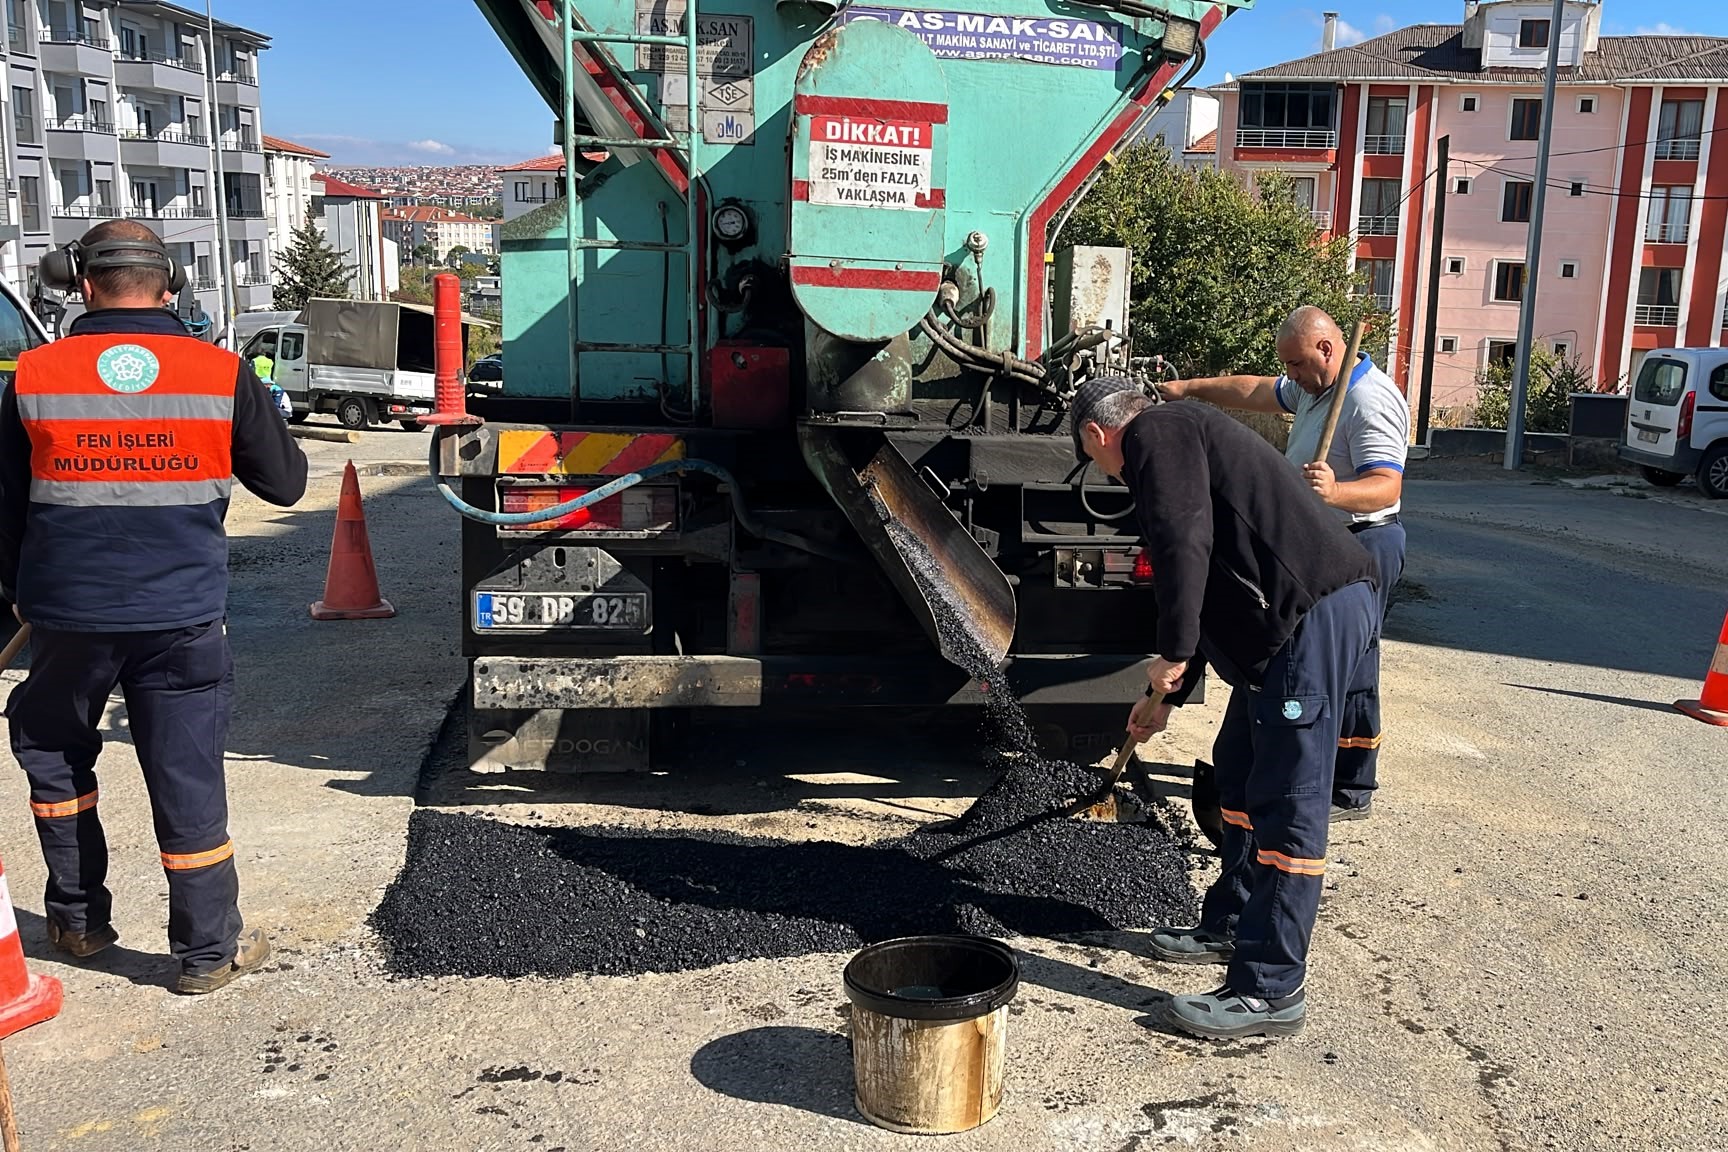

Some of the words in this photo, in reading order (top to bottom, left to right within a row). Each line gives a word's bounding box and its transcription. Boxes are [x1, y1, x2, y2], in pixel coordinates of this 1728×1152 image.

[650, 18, 738, 36] AS.MK.SAN
[898, 11, 1119, 43] AS-MAK-SAN
[936, 32, 977, 48] MAKİNA
[979, 36, 1016, 50] SANAYİ
[1019, 42, 1031, 51] ve
[1033, 39, 1076, 55] TİCARET
[930, 48, 1098, 66] ww.asmaksan.com
[719, 86, 738, 101] TSE
[826, 118, 920, 146] DİKKAT!
[825, 145, 838, 163] İŞ
[840, 147, 920, 166] MAKİNESİNE
[881, 171, 919, 185] FAZLA
[836, 187, 906, 205] YAKLAŞMA
[76, 433, 112, 449] FEN
[117, 430, 174, 451] İŞLERİ
[54, 454, 199, 472] MÜDÜRLÜĞÜ
[480, 612, 491, 621] TR
[492, 596, 525, 623] 59
[542, 597, 575, 623] DB
